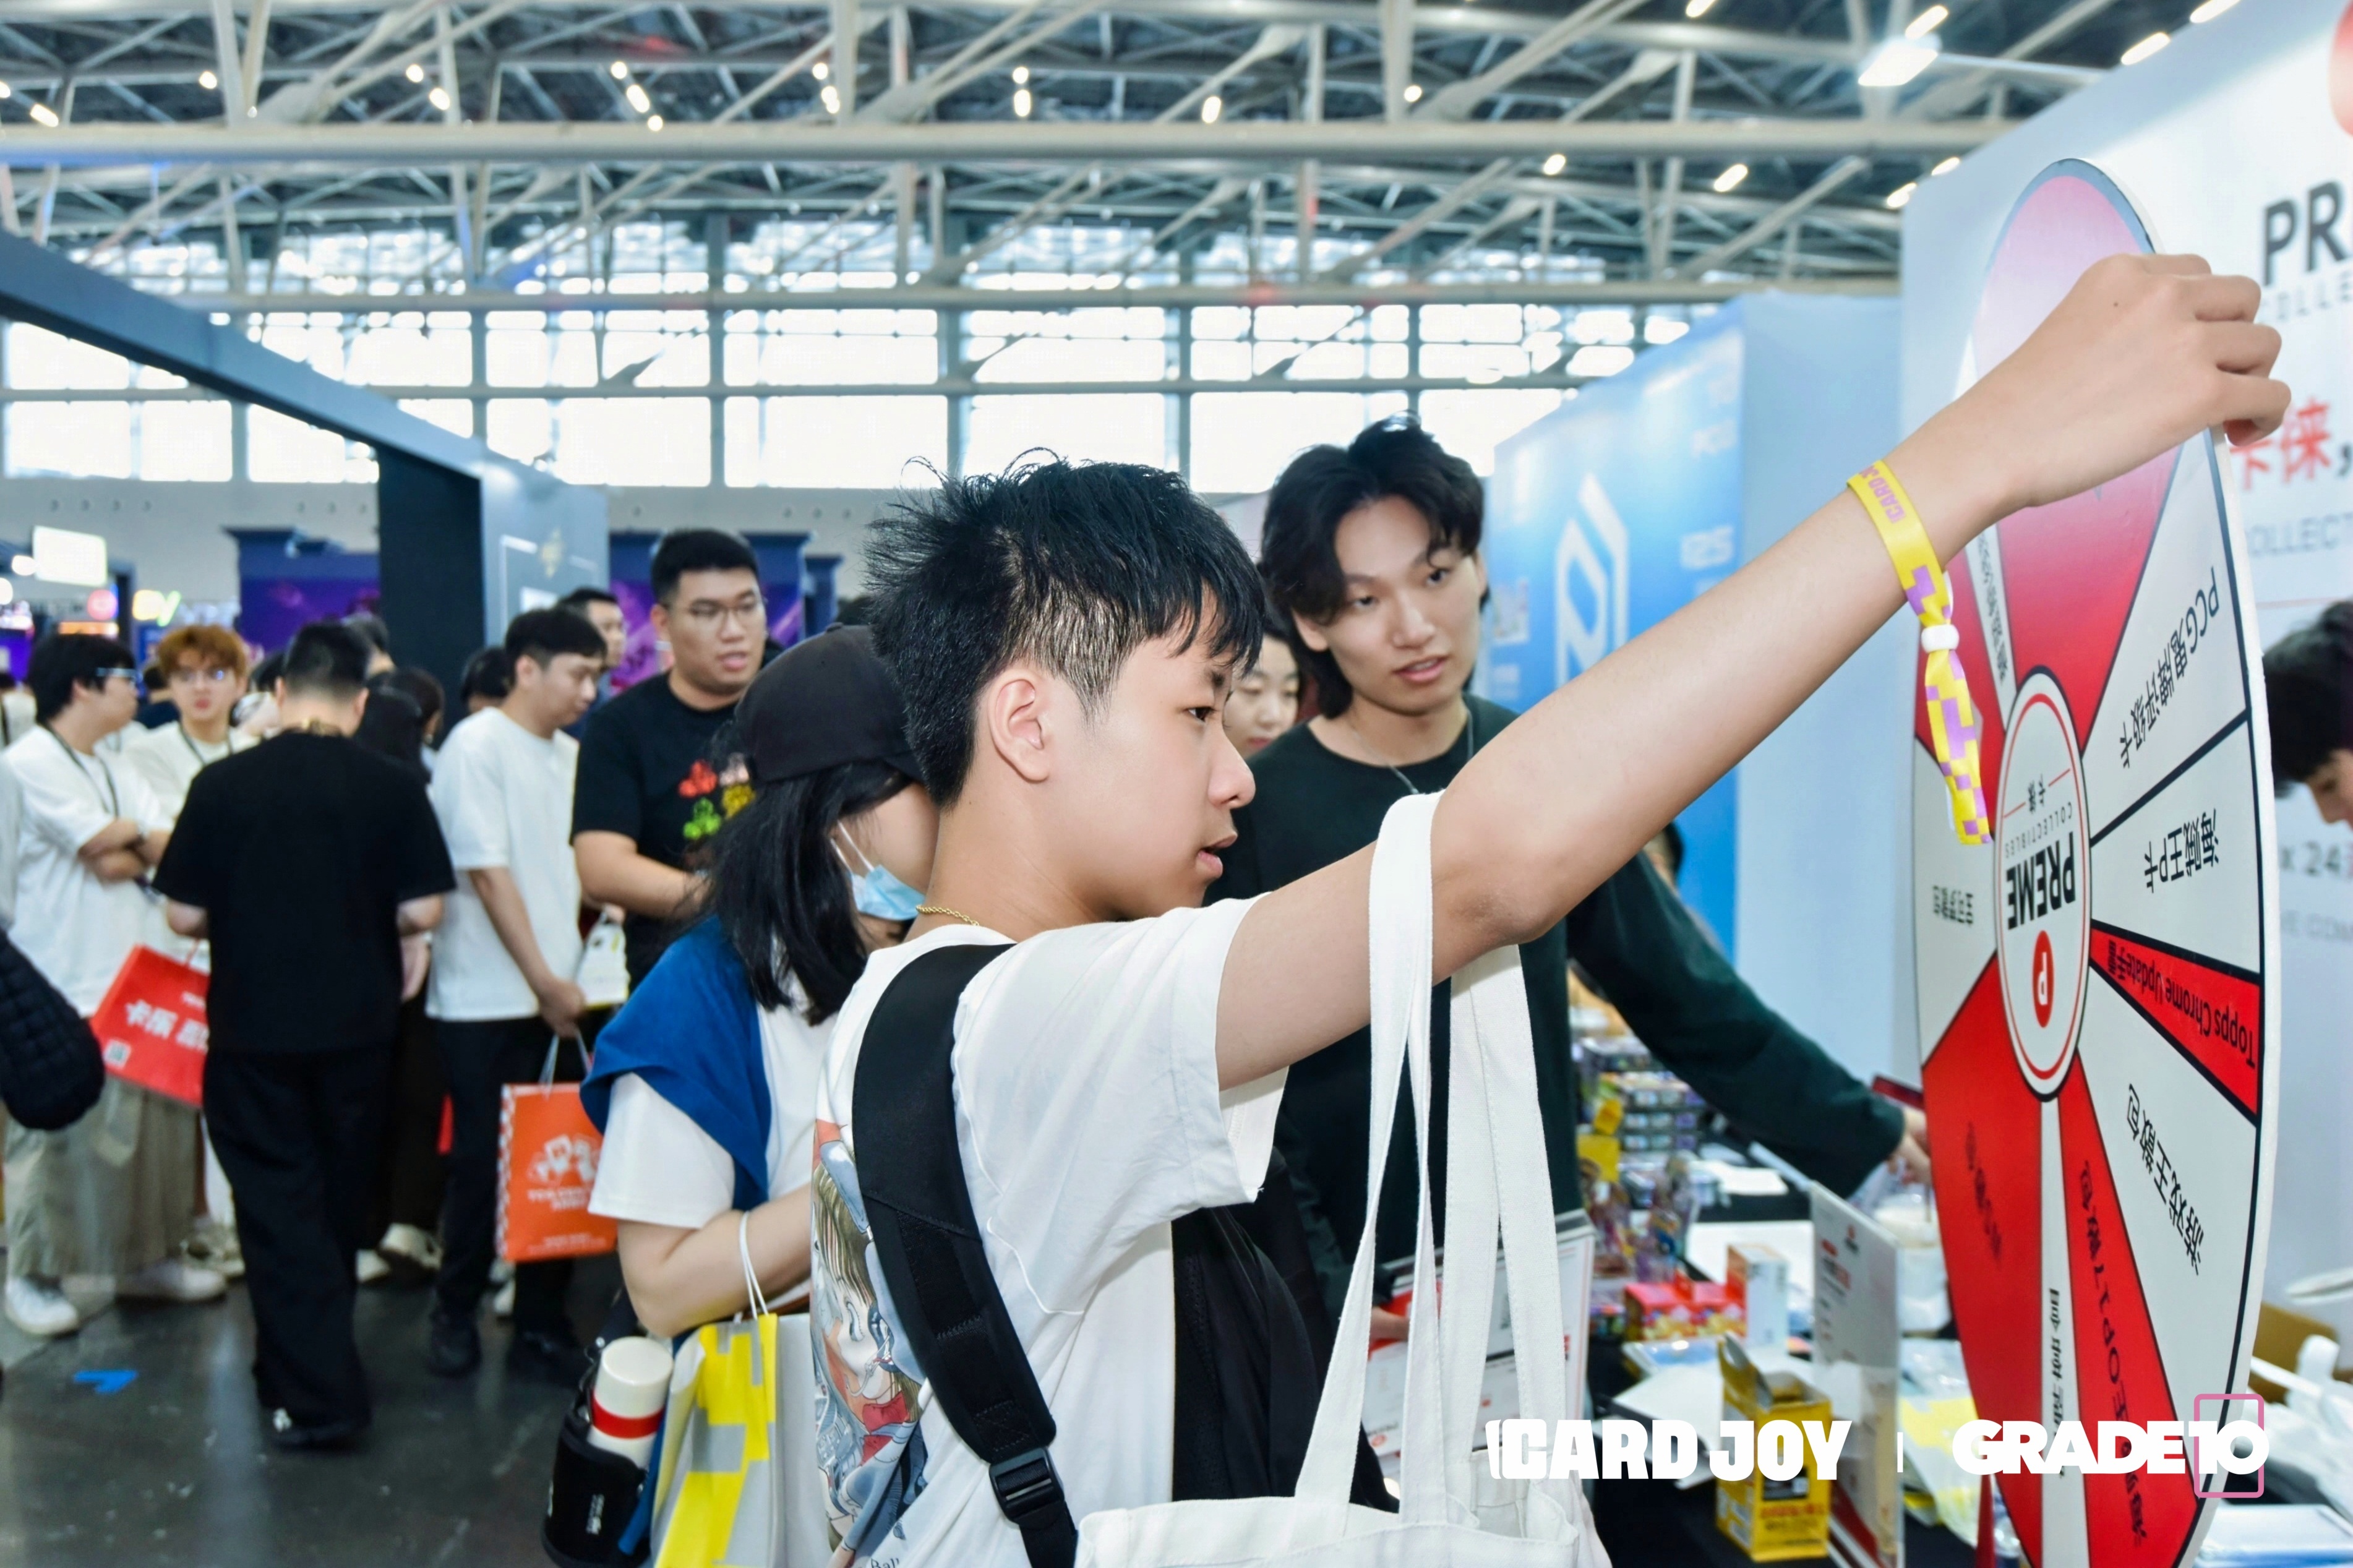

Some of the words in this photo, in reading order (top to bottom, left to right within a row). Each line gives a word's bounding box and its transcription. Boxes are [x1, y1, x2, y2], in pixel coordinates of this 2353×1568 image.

[1868, 477, 1906, 523] CARD
[2119, 566, 2219, 769] PCG鬼牌评级卡
[2004, 801, 2073, 859] COLLECTIBLES
[2144, 807, 2220, 893] 海贼王P卡
[2005, 831, 2077, 930] PREME
[2165, 977, 2211, 1037] Chrome
[2215, 1006, 2255, 1067] Topps
[2127, 1084, 2204, 1275] 游戏王散包
